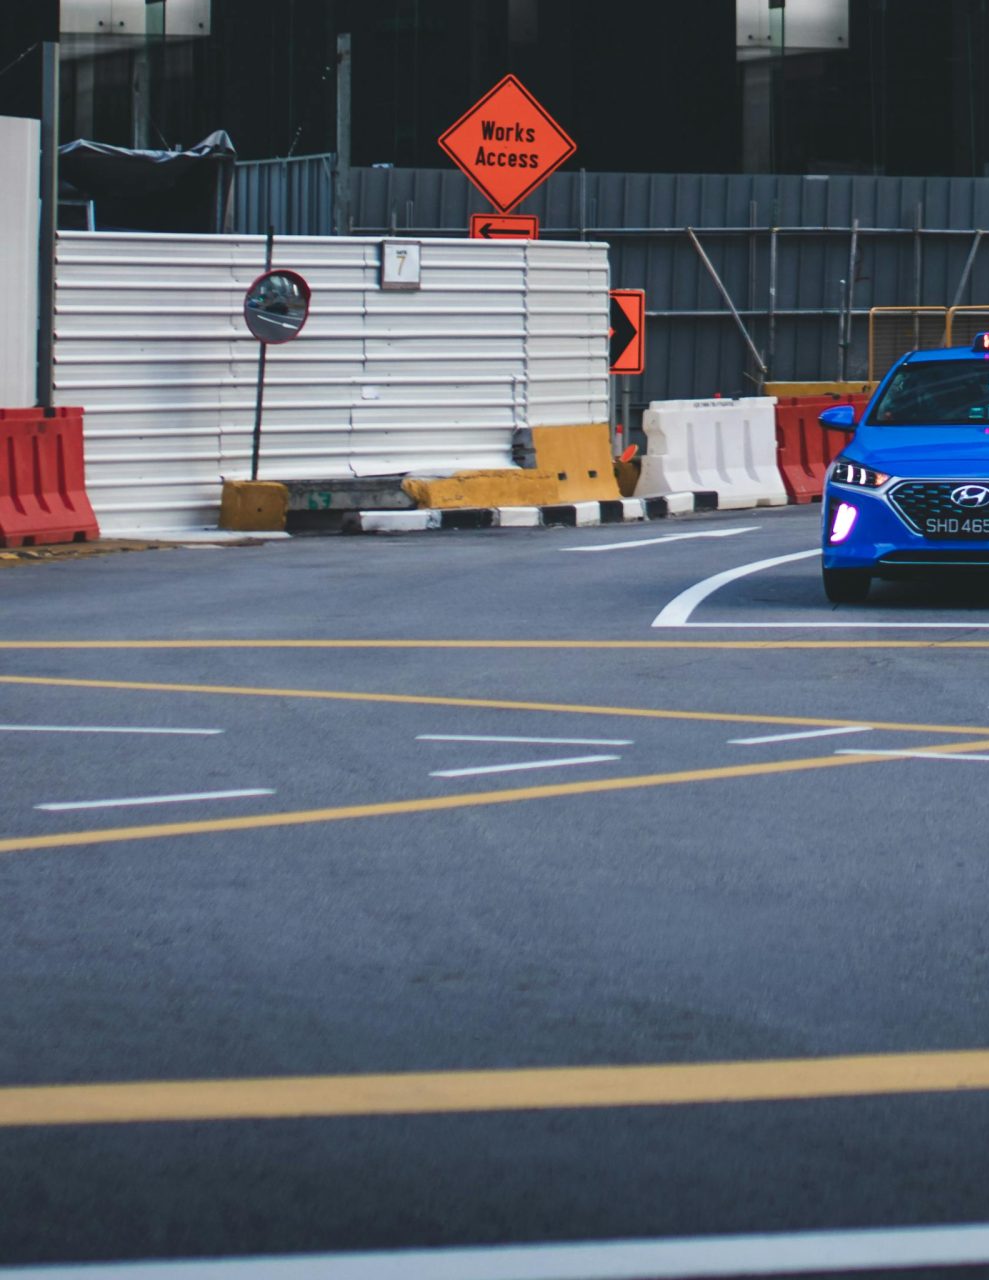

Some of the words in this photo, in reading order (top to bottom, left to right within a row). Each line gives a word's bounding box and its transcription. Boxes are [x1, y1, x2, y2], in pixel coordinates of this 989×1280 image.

[481, 120, 535, 143] Works
[475, 146, 539, 168] Access
[396, 255, 406, 276] 7
[926, 518, 958, 533] SHD
